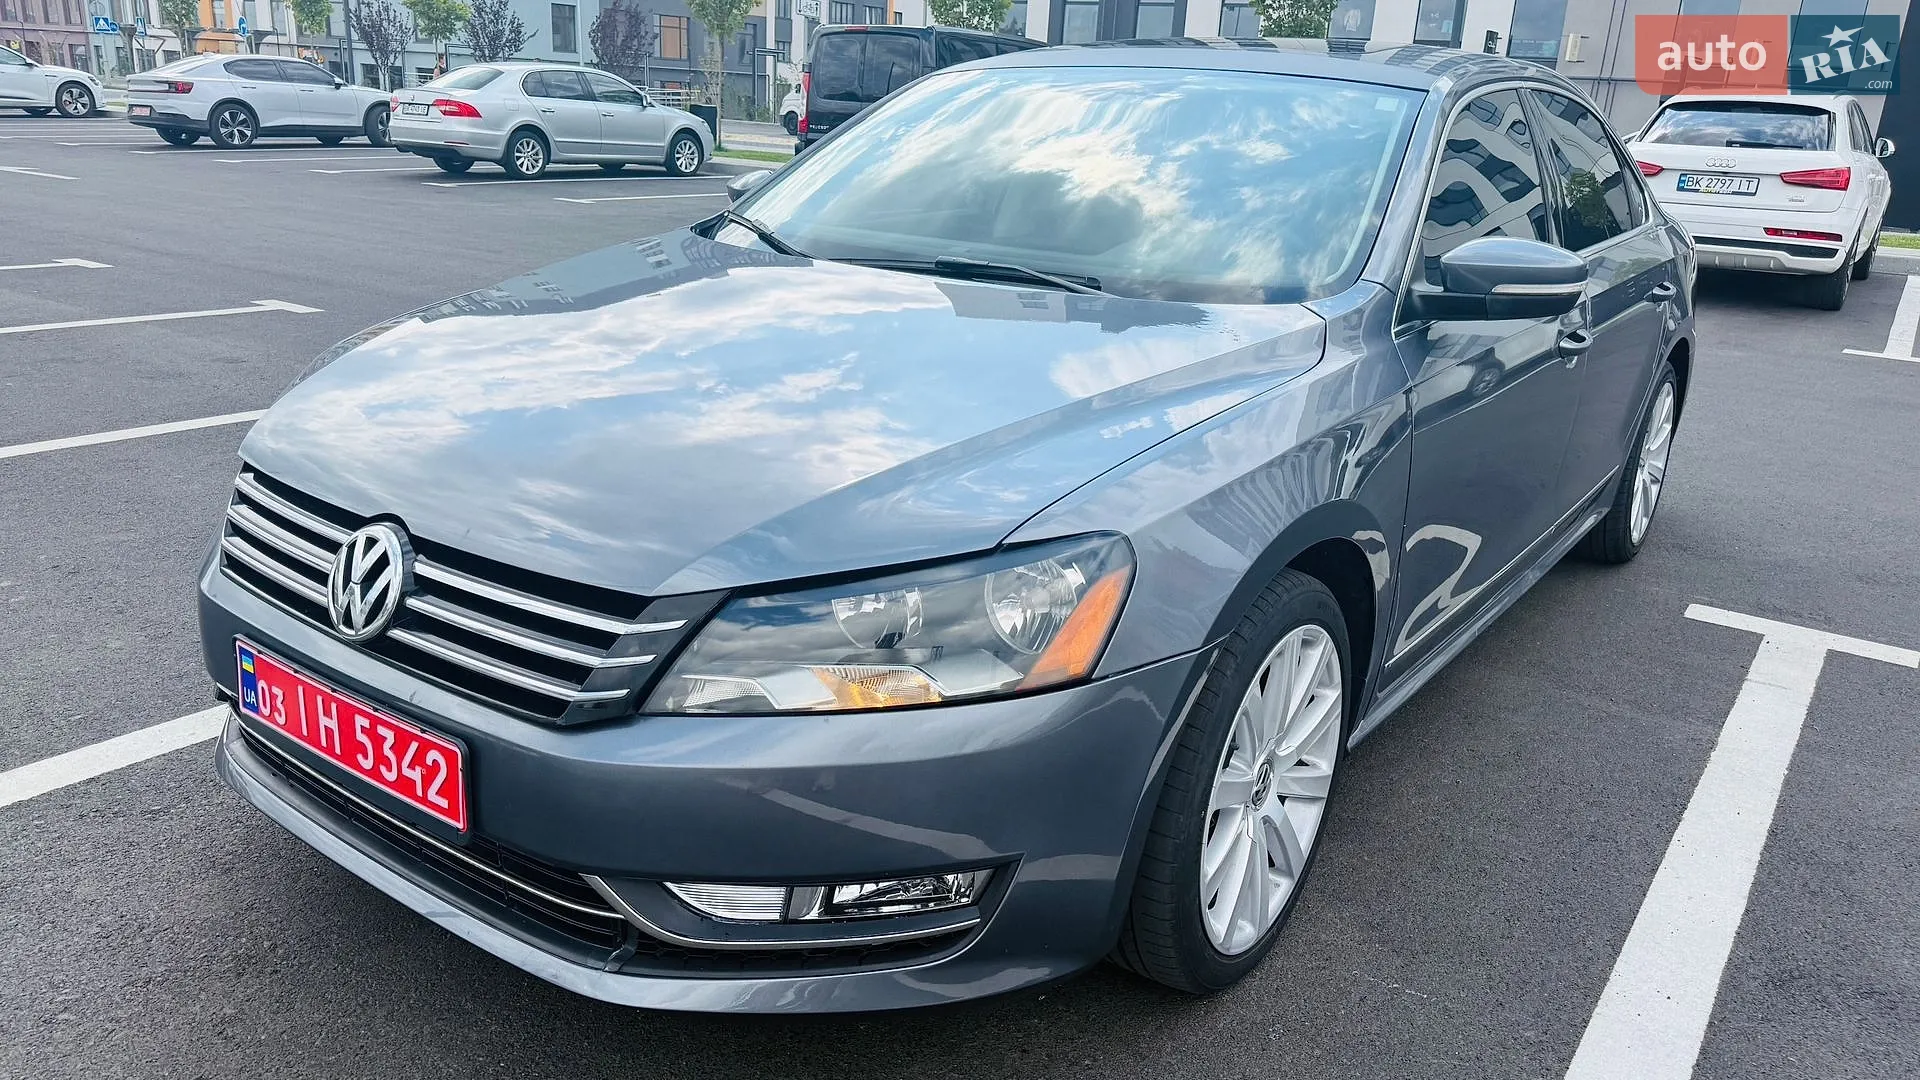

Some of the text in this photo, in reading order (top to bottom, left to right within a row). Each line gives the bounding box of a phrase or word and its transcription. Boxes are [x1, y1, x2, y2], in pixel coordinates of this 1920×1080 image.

[1686, 176, 1703, 188] BK
[1705, 177, 1734, 189] 2797
[1738, 179, 1754, 191] IT
[243, 686, 258, 707] UA
[257, 679, 449, 809] 03 IH 5342
